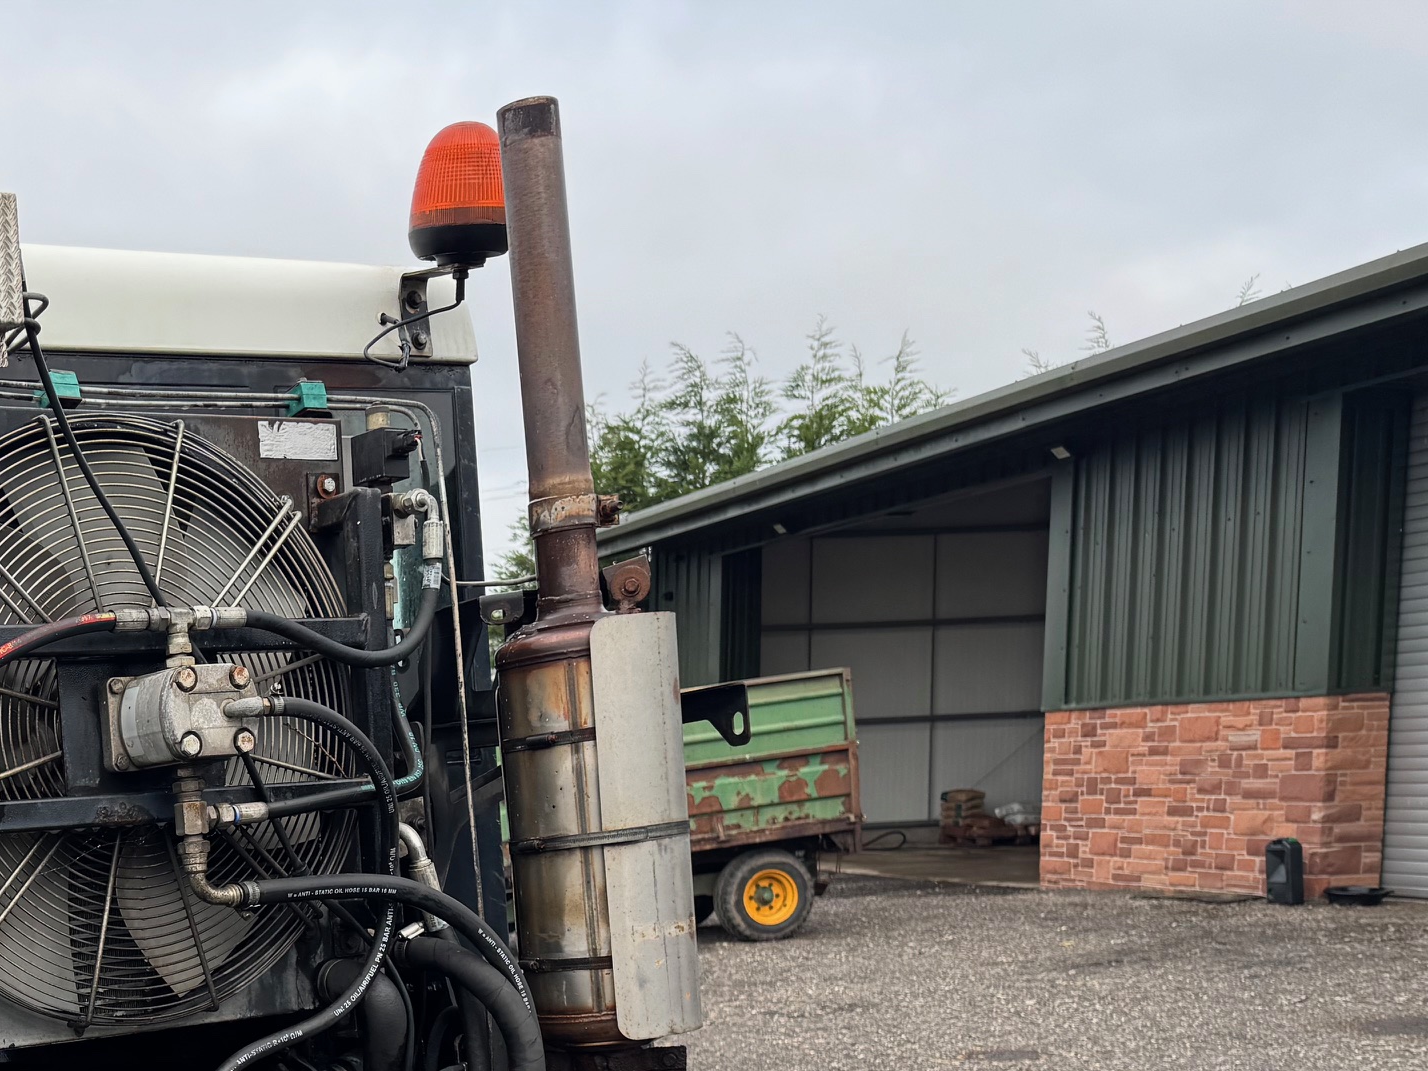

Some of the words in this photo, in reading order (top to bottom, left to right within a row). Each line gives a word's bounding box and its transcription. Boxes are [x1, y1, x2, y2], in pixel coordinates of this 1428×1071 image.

[314, 888, 334, 896] STATIC
[381, 926, 392, 944] BAR
[378, 943, 387, 953] 25
[374, 951, 384, 963] PN
[496, 947, 512, 966] STATIC
[508, 964, 516, 975] OIL
